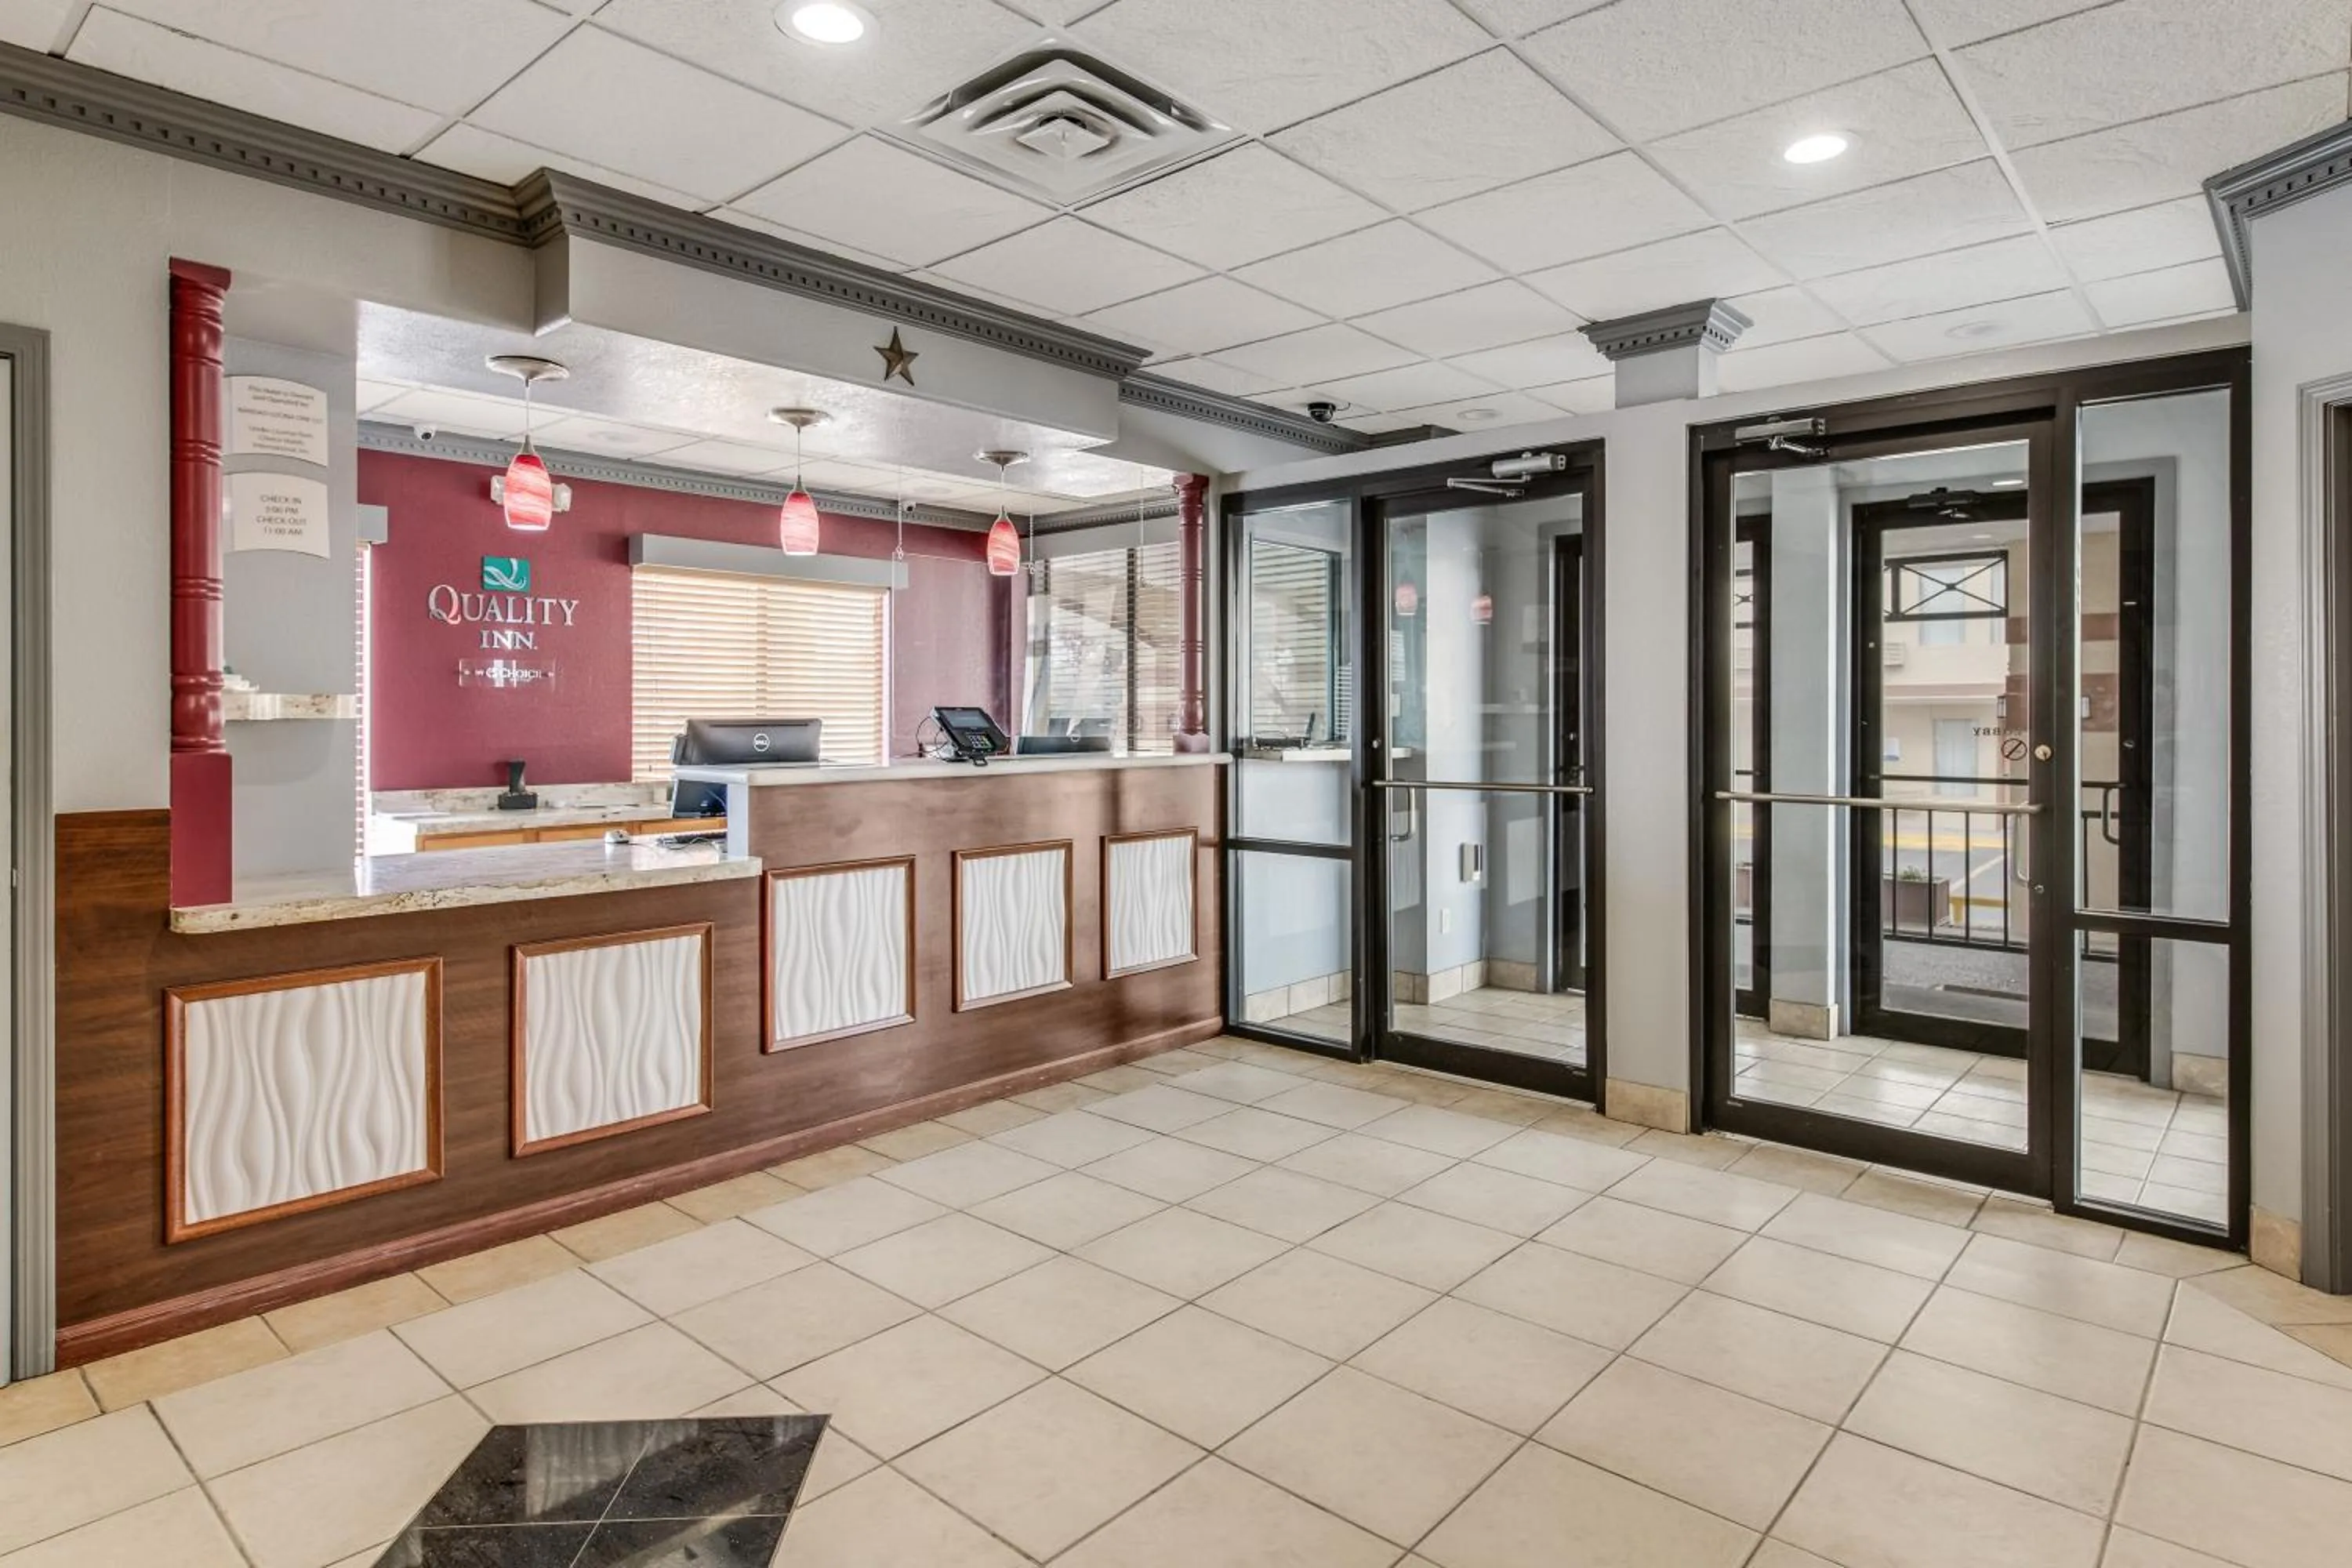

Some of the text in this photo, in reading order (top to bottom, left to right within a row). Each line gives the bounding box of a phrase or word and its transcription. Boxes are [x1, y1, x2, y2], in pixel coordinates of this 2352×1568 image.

[260, 495, 289, 503] CHECK
[256, 515, 307, 526] CHECK OUT
[428, 584, 579, 626] QUALITY
